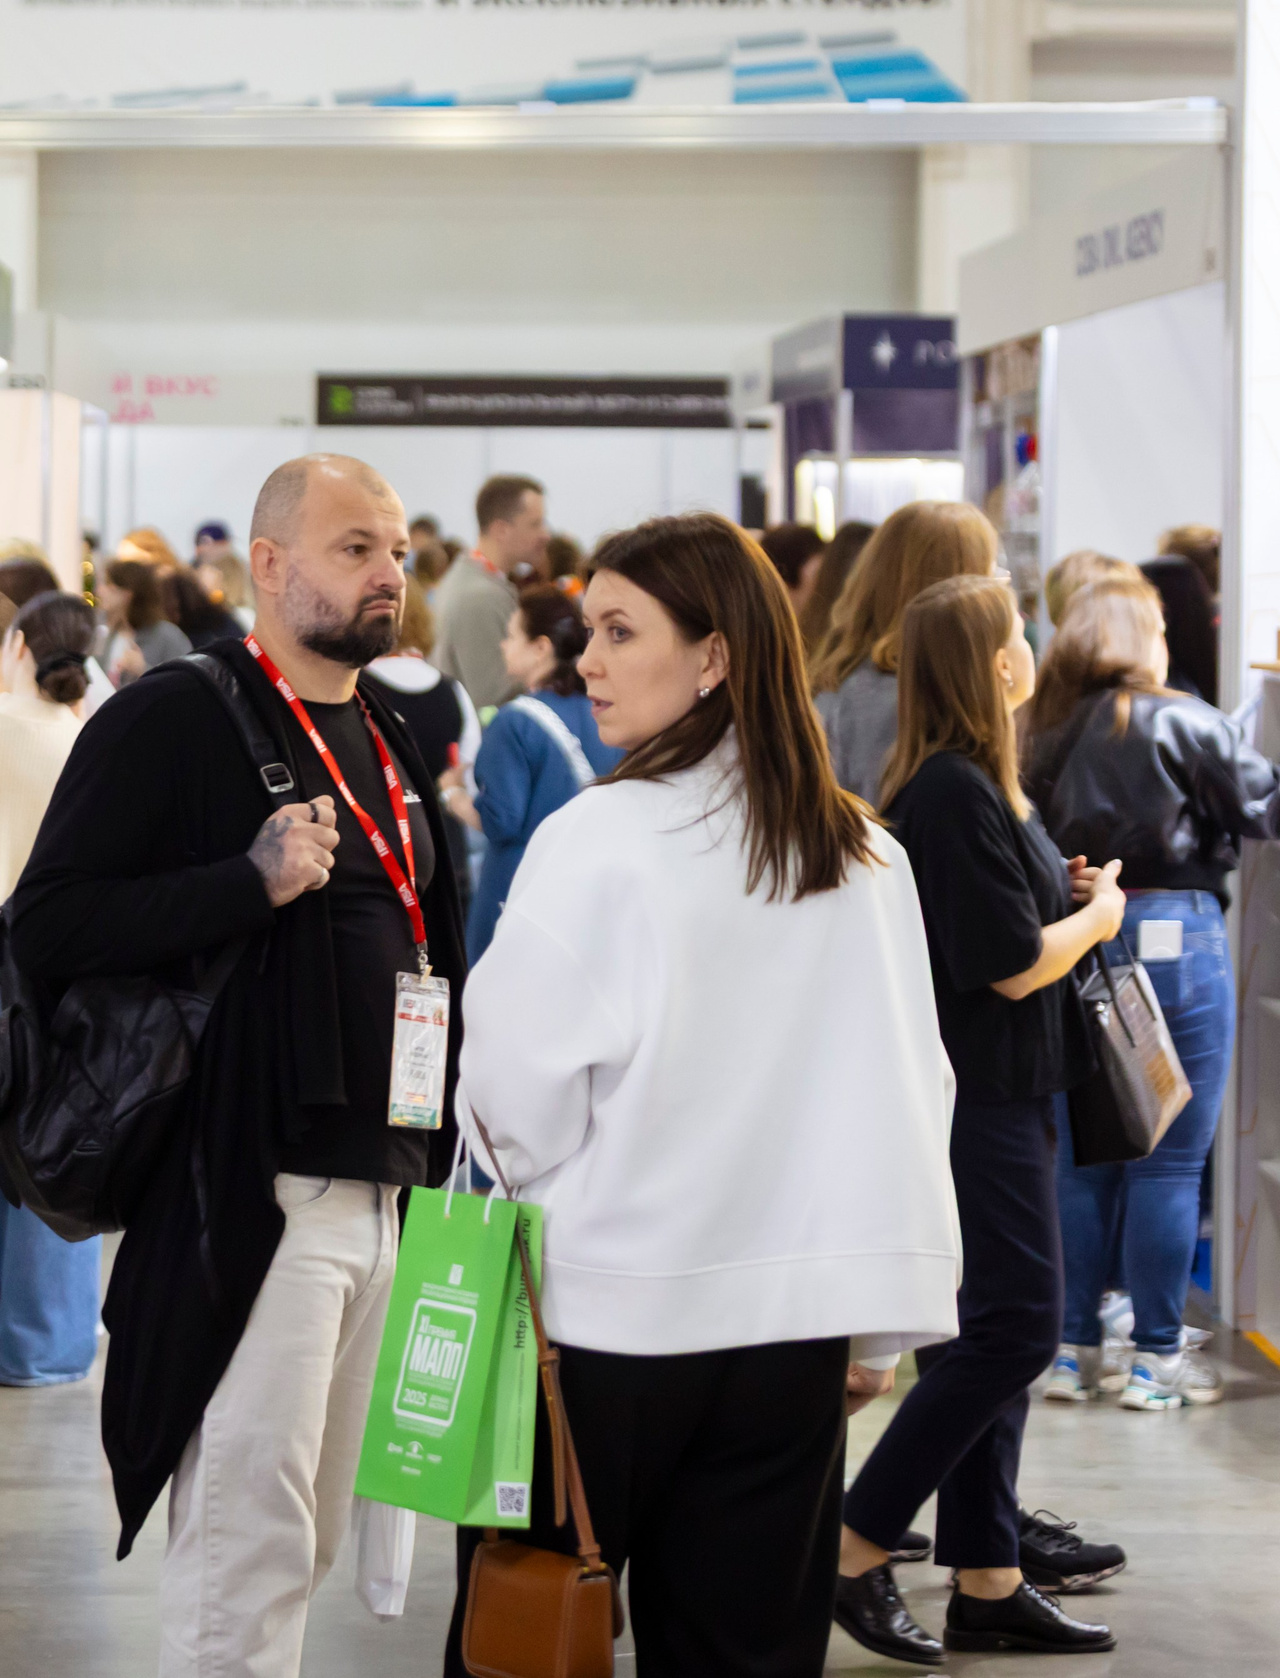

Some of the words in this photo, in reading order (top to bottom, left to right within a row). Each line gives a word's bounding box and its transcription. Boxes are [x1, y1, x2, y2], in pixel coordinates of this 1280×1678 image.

[276, 677, 297, 701] IPSA
[370, 831, 389, 857] IPSA
[397, 882, 416, 907] IPSA
[409, 1334, 464, 1381] МАПП
[402, 1388, 428, 1407] 2025
